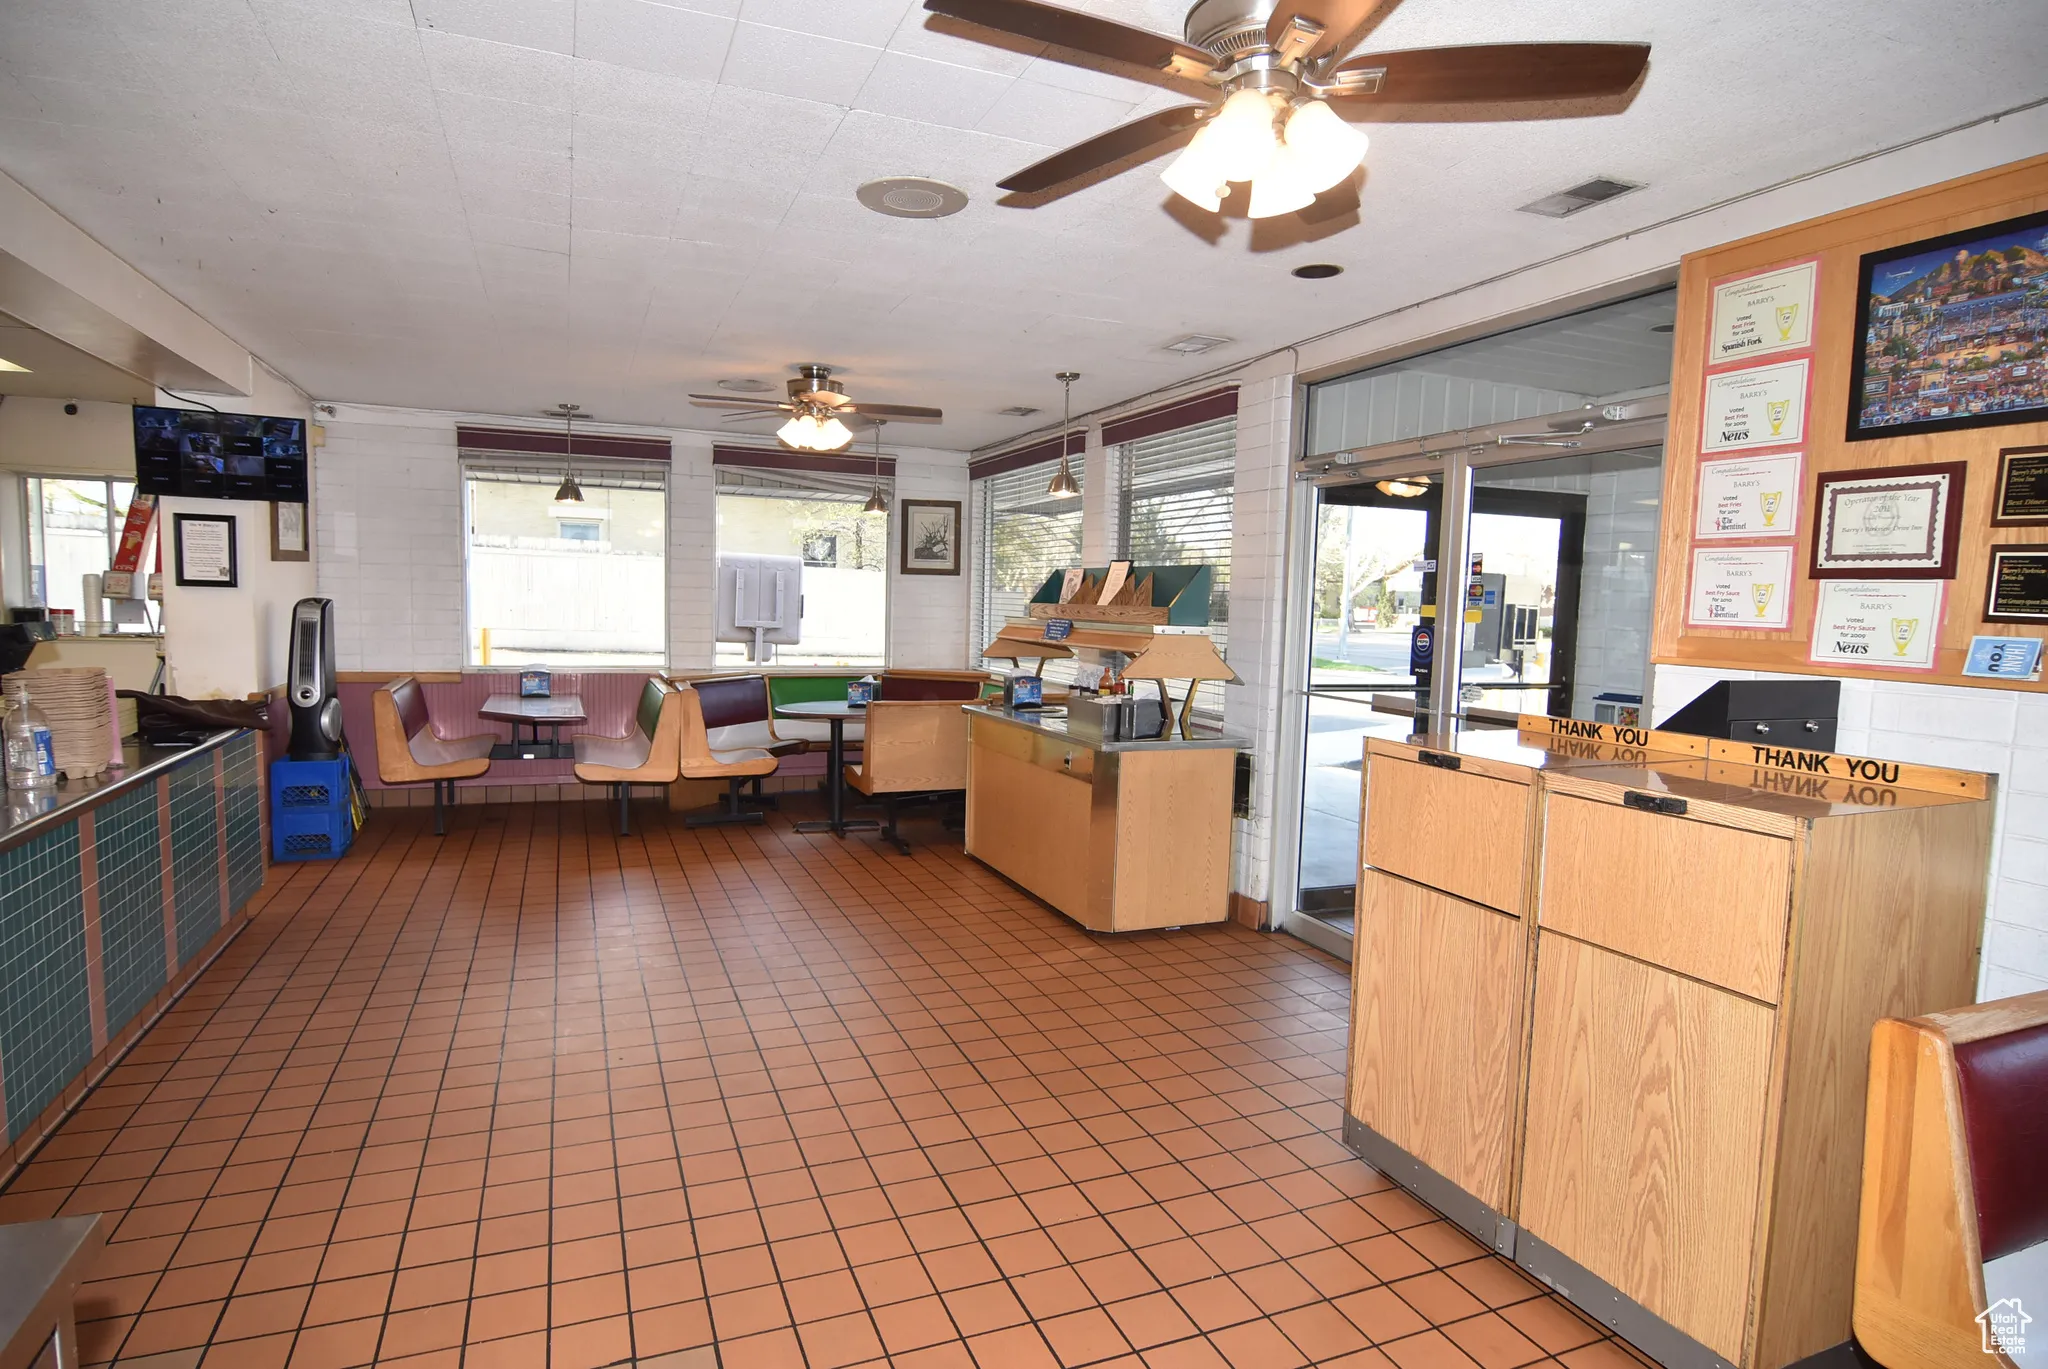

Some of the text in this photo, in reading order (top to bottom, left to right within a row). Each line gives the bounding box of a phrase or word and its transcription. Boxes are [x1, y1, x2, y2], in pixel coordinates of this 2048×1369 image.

[1748, 296, 1774, 307] BARRY'S
[1722, 337, 1762, 352] Spanish Fork
[1740, 390, 1768, 400] BARRY'S
[1720, 430, 1750, 442] News
[1734, 480, 1760, 488] BARRY'S
[1834, 584, 1880, 594] Congratulations
[1832, 641, 1870, 654] News
[1988, 644, 2006, 672] YOU
[2000, 644, 2028, 672] THANK
[1548, 718, 1648, 746] THANK YOU
[1752, 746, 1900, 783] THANK YOU
